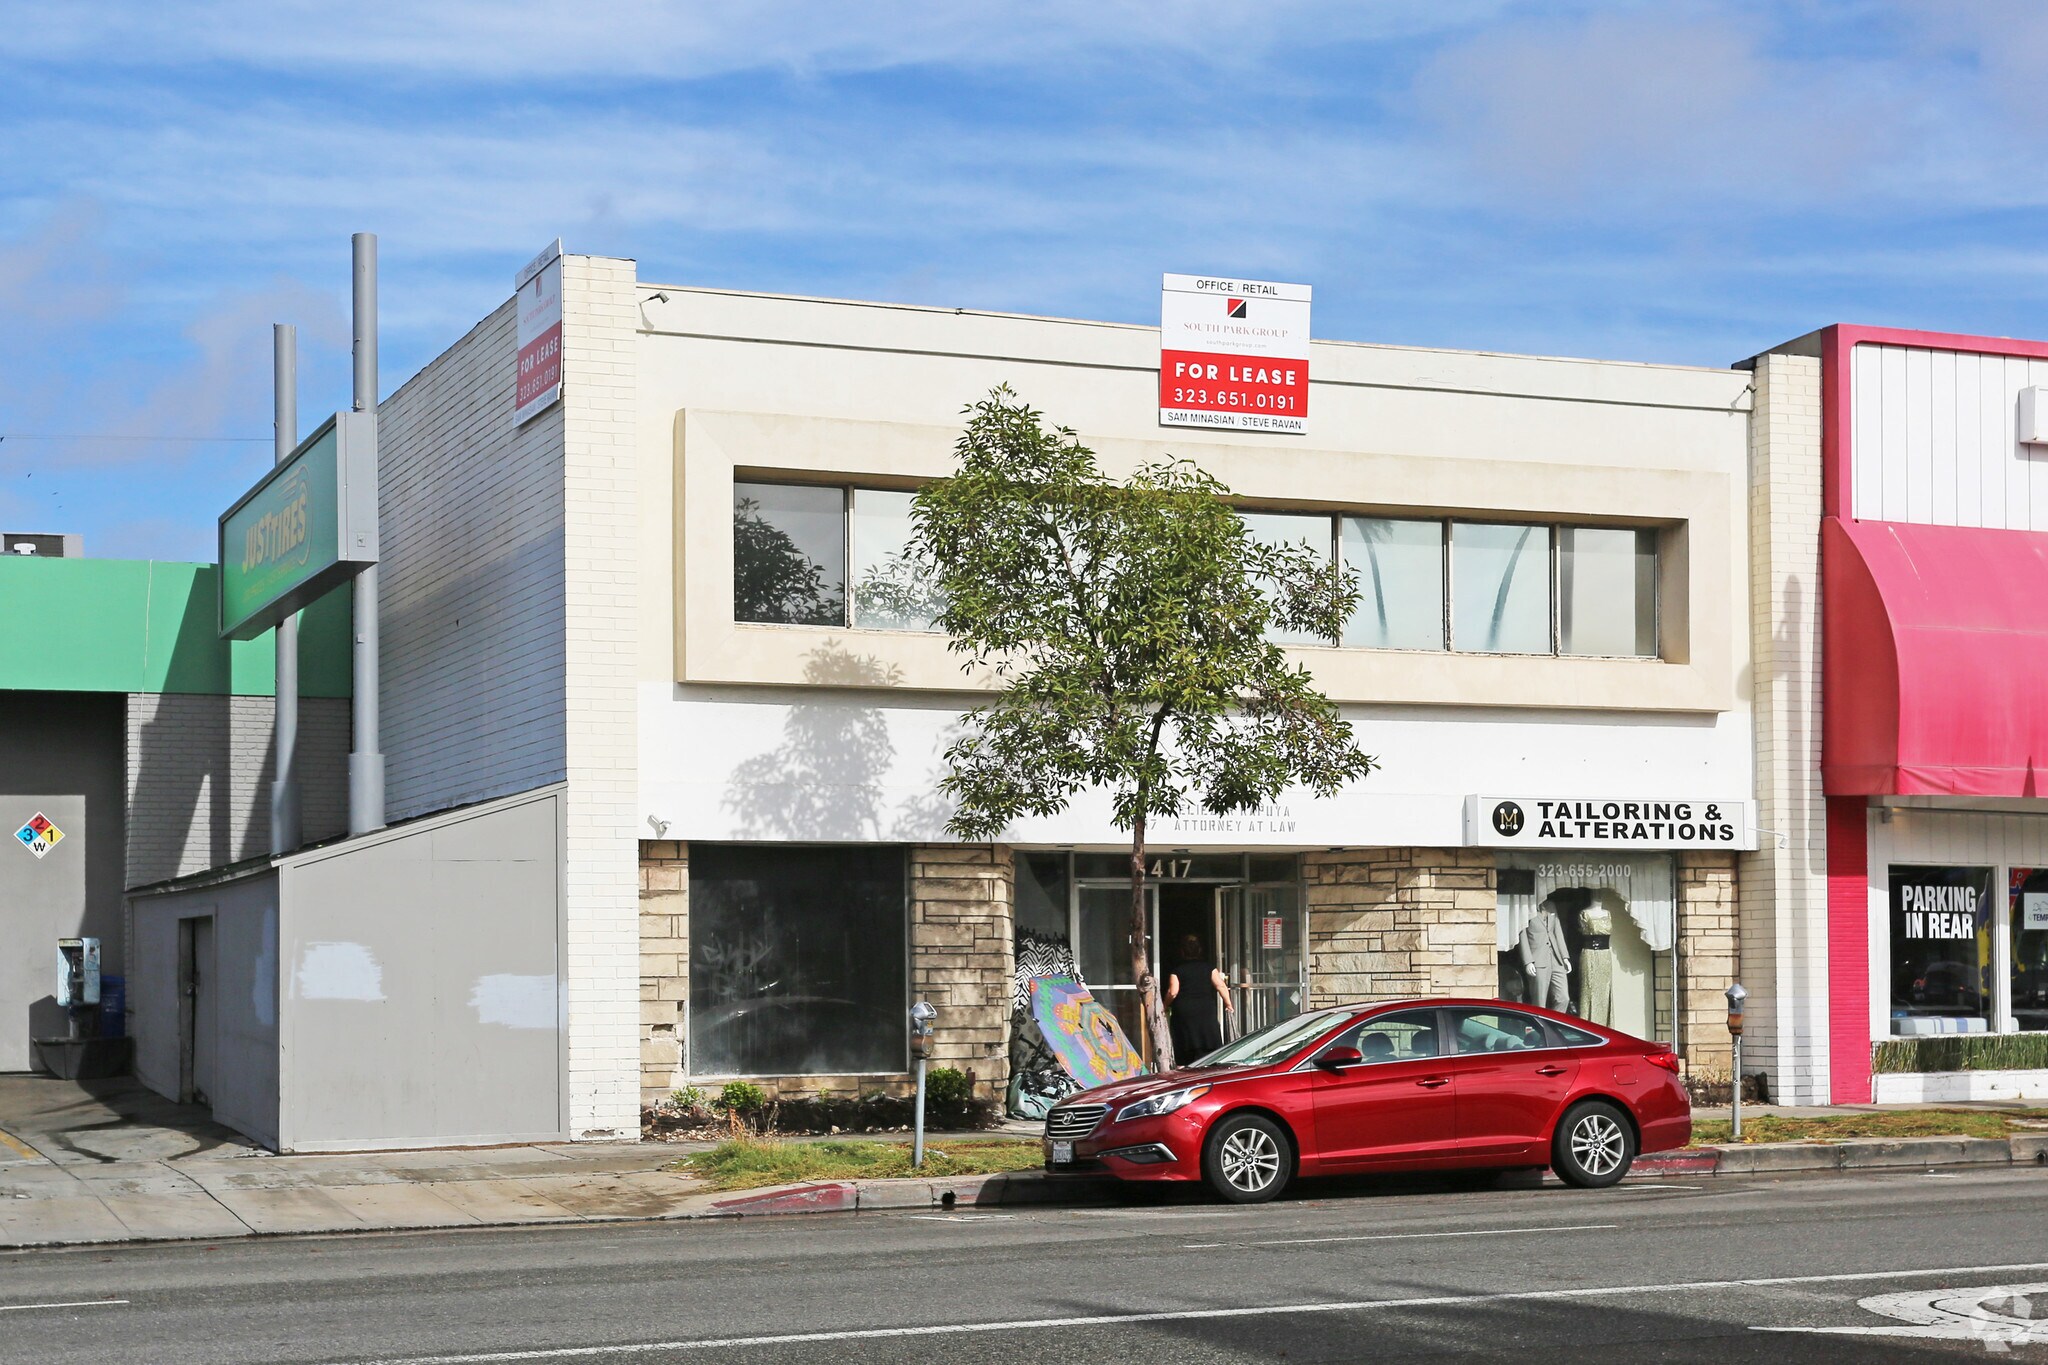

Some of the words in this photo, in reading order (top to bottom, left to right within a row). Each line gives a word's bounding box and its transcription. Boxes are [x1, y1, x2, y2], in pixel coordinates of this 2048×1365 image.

[1196, 279, 1234, 292] OFFICE
[1242, 283, 1279, 296] RETAIL
[1183, 322, 1220, 333] SOUTH
[1223, 325, 1250, 335] PARK
[1251, 327, 1288, 338] GROUP
[520, 354, 534, 376] FOR
[536, 335, 559, 365] LEASE
[1175, 362, 1218, 380] FOR
[1229, 366, 1296, 386] LEASE
[1173, 388, 1294, 410] 323.651.0191
[1167, 411, 1188, 422] SAM
[1190, 413, 1235, 425] MINASIAN
[1242, 416, 1270, 428] STEVE
[1271, 418, 1302, 430] RAVAN
[1537, 801, 1692, 821] TAILORING
[1704, 803, 1722, 821] &
[34, 815, 45, 830] 2
[1174, 819, 1242, 832] ATTORNEY
[1248, 820, 1264, 832] AT
[1270, 820, 1296, 833] LAW
[1538, 820, 1735, 841] ALTERATIONS
[22, 827, 34, 843] 3
[46, 829, 54, 843] 1
[1151, 859, 1192, 879] 417
[1538, 863, 1632, 878] 323-655-2000
[1901, 885, 1976, 913] PARKING
[1905, 912, 1923, 939] IN
[1928, 912, 1974, 939] REAR
